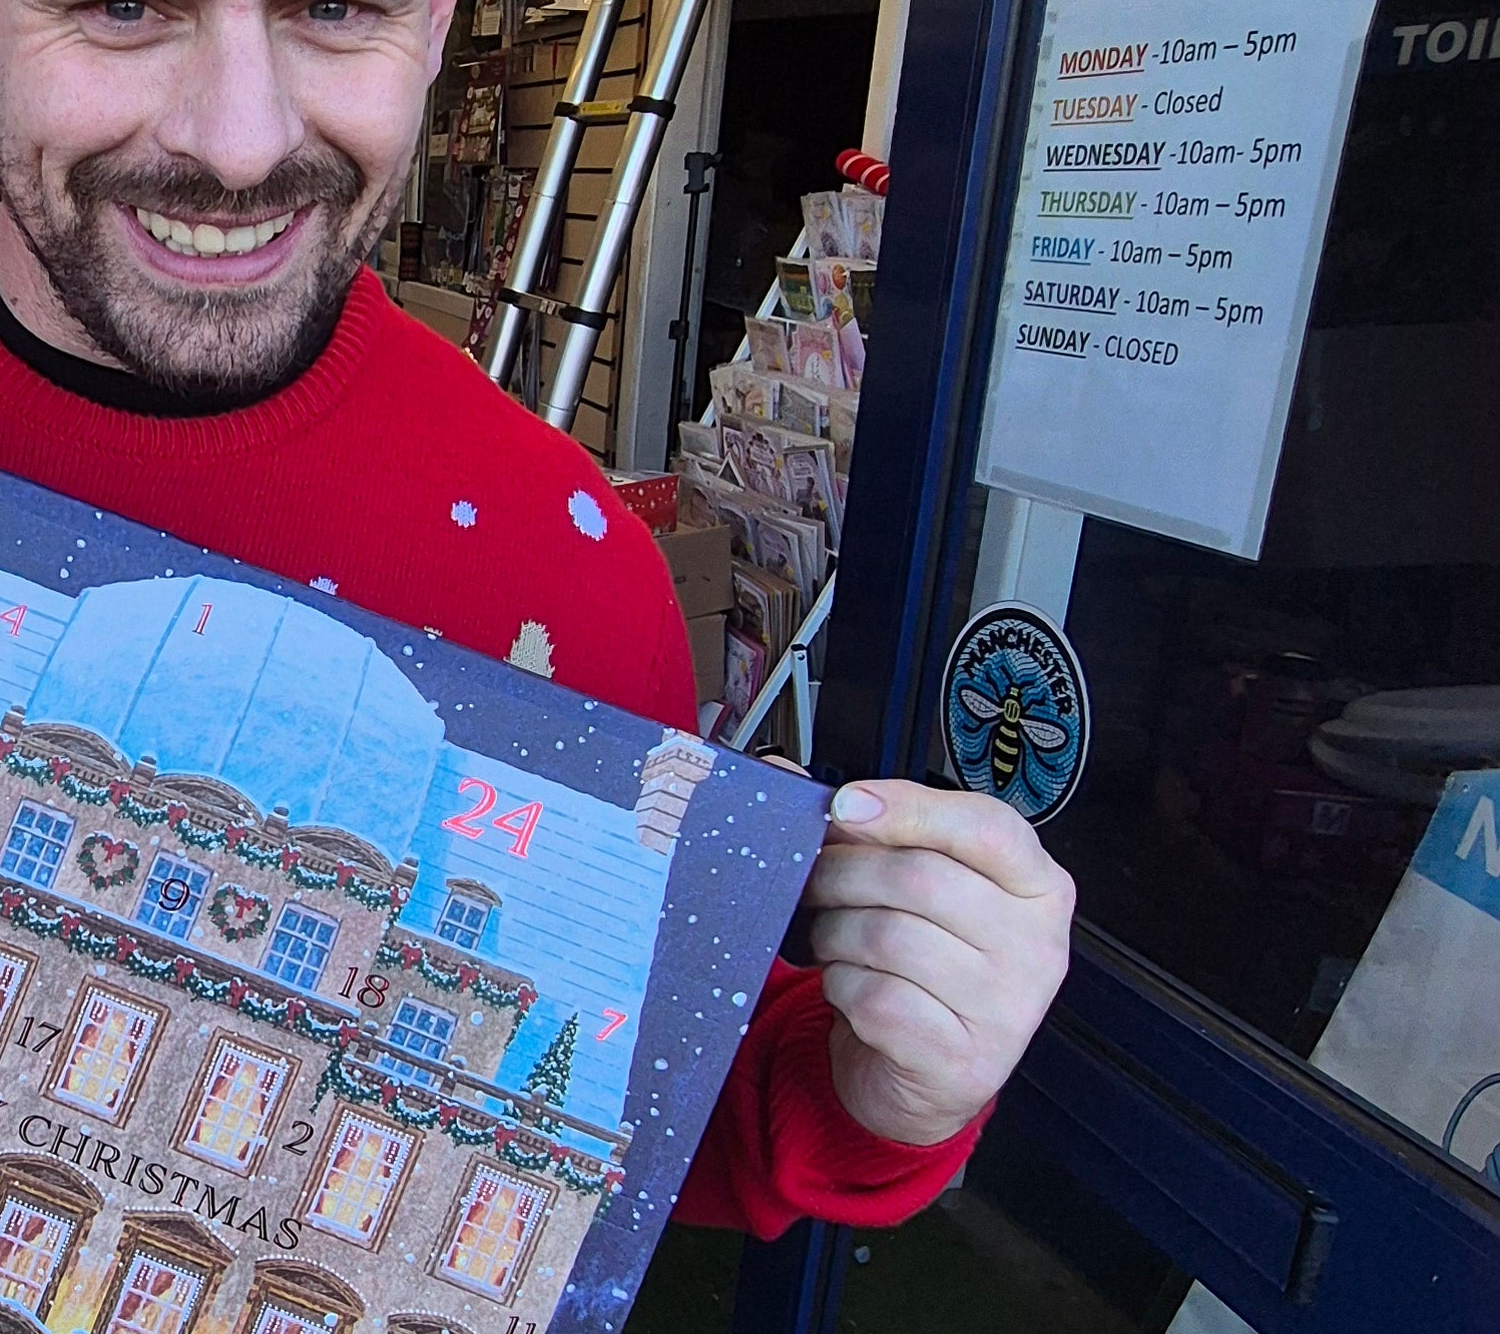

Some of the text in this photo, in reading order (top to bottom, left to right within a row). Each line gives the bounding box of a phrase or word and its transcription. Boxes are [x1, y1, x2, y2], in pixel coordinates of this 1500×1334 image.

[1060, 43, 1149, 75] MONDAY
[1244, 31, 1297, 61] 5pm
[1053, 85, 1223, 121] TUESDAY Closed
[1046, 141, 1166, 166] WEDNESDAY
[1250, 138, 1301, 169] 5pm
[1041, 191, 1286, 223] THURSDAY 10am 5pm
[1032, 236, 1233, 274] FRIDAY 10am 5pm
[1024, 280, 1264, 328] SATURDAY 10am 5pm
[1016, 324, 1179, 366] SUNDAY CLOSED
[0, 602, 214, 637] 4 1
[963, 627, 1073, 716] MANCHESTER
[442, 777, 544, 860] 24
[156, 877, 192, 913] 9
[337, 966, 391, 1010] 18
[595, 1007, 629, 1042] 7
[14, 1016, 63, 1054] 17
[282, 1120, 316, 1158] 2
[18, 1114, 303, 1251] CHRISTMAS
